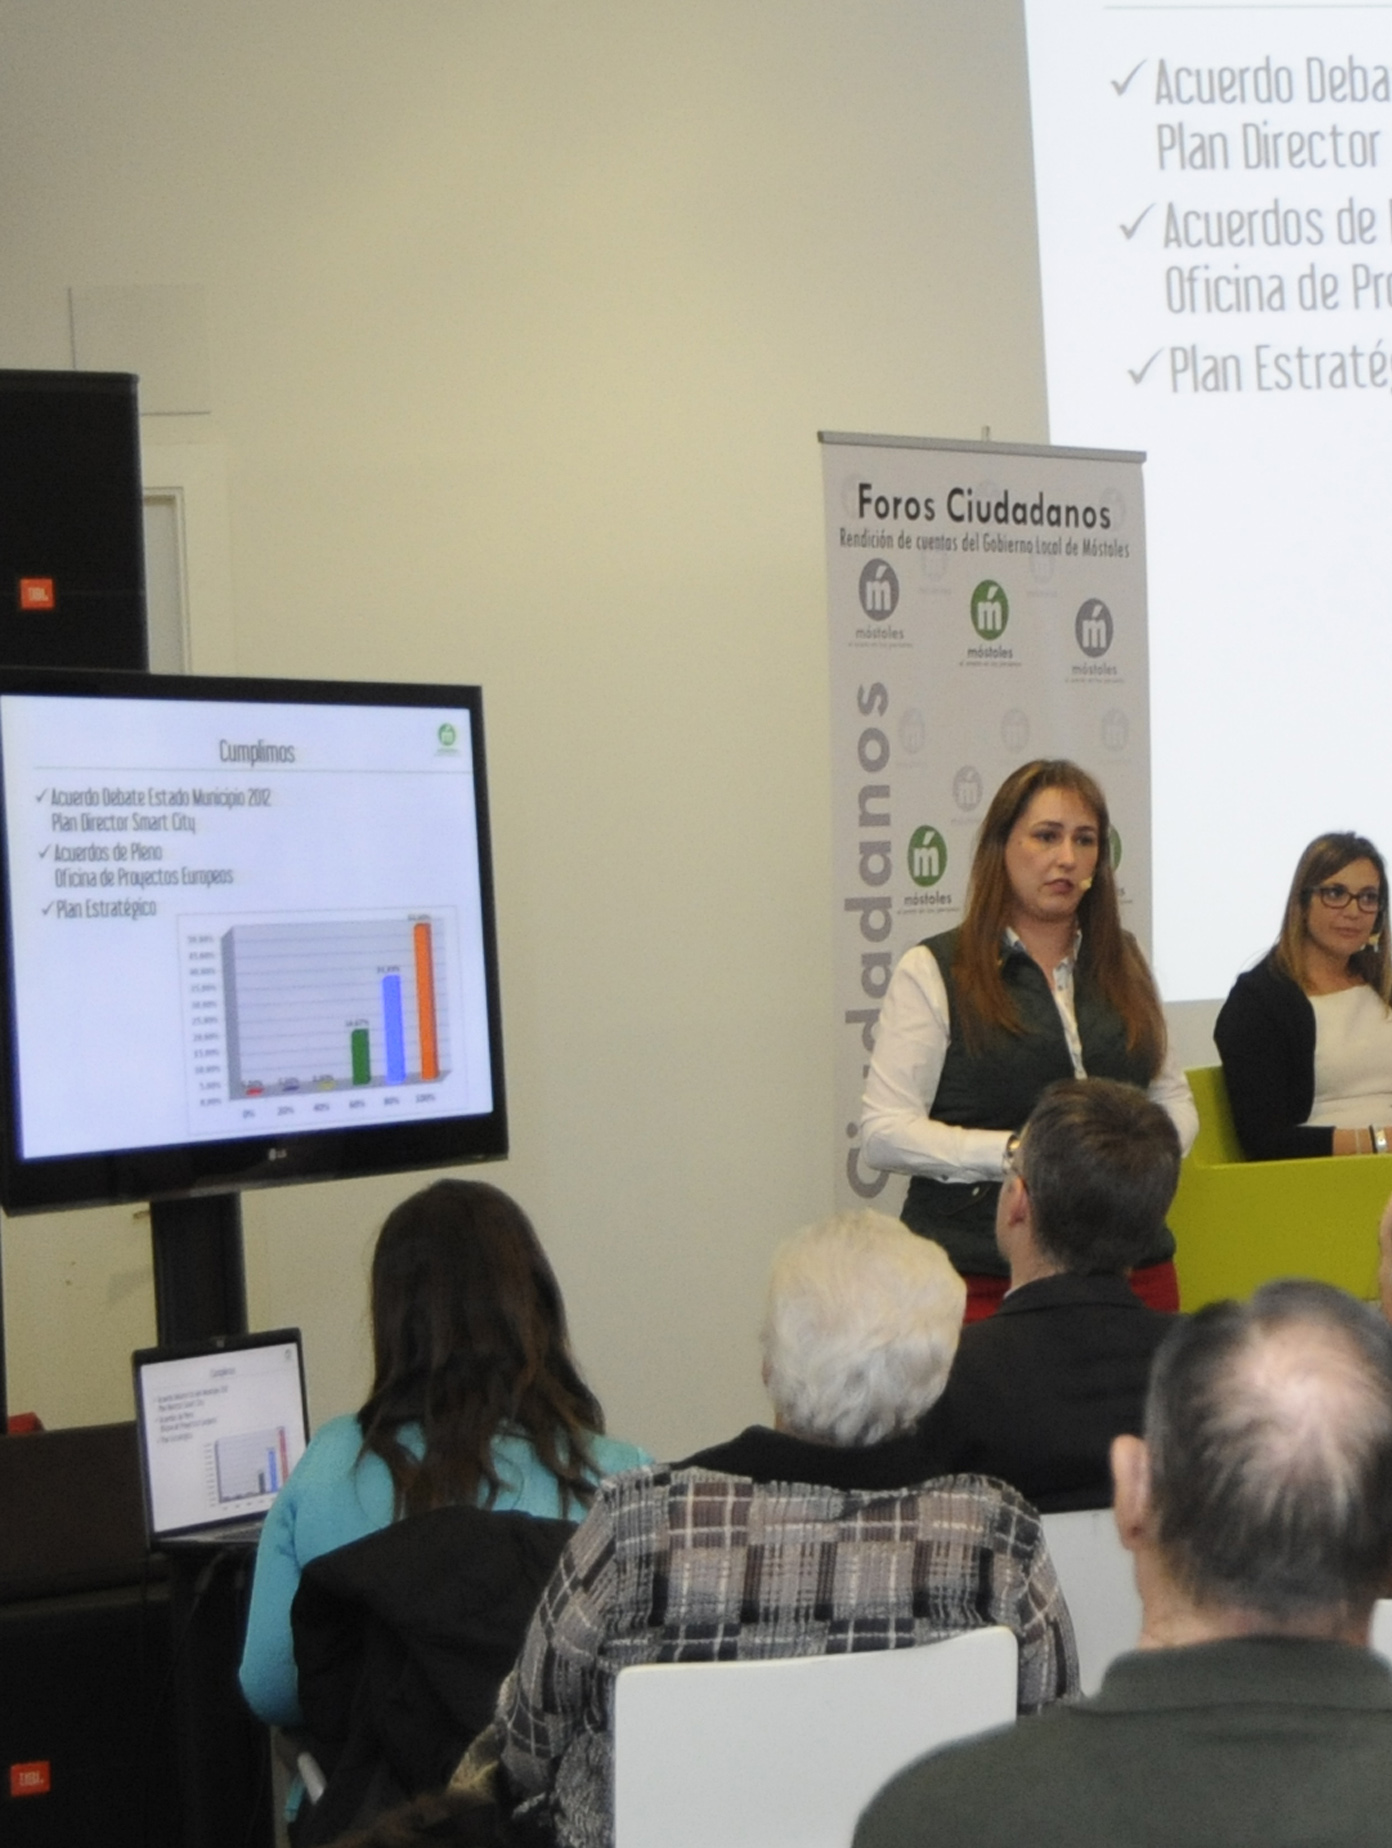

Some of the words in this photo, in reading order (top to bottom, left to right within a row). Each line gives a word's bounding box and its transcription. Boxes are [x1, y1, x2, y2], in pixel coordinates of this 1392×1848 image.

[1154, 55, 1294, 105] Acuerdo
[1156, 123, 1230, 170] Plan
[1242, 120, 1381, 169] Director
[1163, 198, 1324, 249] Acuerdos
[1336, 197, 1377, 245] de
[1165, 264, 1285, 315] Oficina
[1298, 263, 1340, 311] de
[1169, 344, 1242, 393] Plan
[858, 482, 936, 522] Foros
[947, 487, 1111, 529] Ciudadanos
[839, 527, 895, 549] Rendición
[897, 530, 912, 550] de
[916, 533, 958, 551] cuentas
[962, 532, 979, 552] del
[983, 533, 1033, 554] Gobierno
[1035, 537, 1062, 555] Local
[1065, 537, 1079, 557] de
[1082, 538, 1130, 559] Móstoles
[855, 625, 905, 640] móstoles
[967, 644, 1014, 659] móstoles
[1071, 662, 1119, 677] móstoles
[219, 739, 296, 767] Cumplimos
[51, 788, 99, 807] Acuerdo
[102, 787, 145, 806] Debate
[148, 787, 189, 806] Estado
[247, 788, 272, 807] 2012
[51, 813, 77, 832] Plan
[81, 812, 129, 832] Director
[132, 811, 169, 831] Smart
[171, 812, 196, 834] City
[54, 842, 110, 862] Acuerdos
[113, 842, 128, 861] de
[131, 841, 163, 861] Pleno
[54, 867, 97, 888] Oficina
[100, 867, 114, 886] de
[117, 867, 179, 890] Proyectos
[181, 866, 233, 889] Europeos
[56, 900, 82, 919] Plan
[85, 897, 157, 921] Estratégico
[903, 891, 952, 906] móstoles
[844, 682, 893, 1199] Cdadanos
